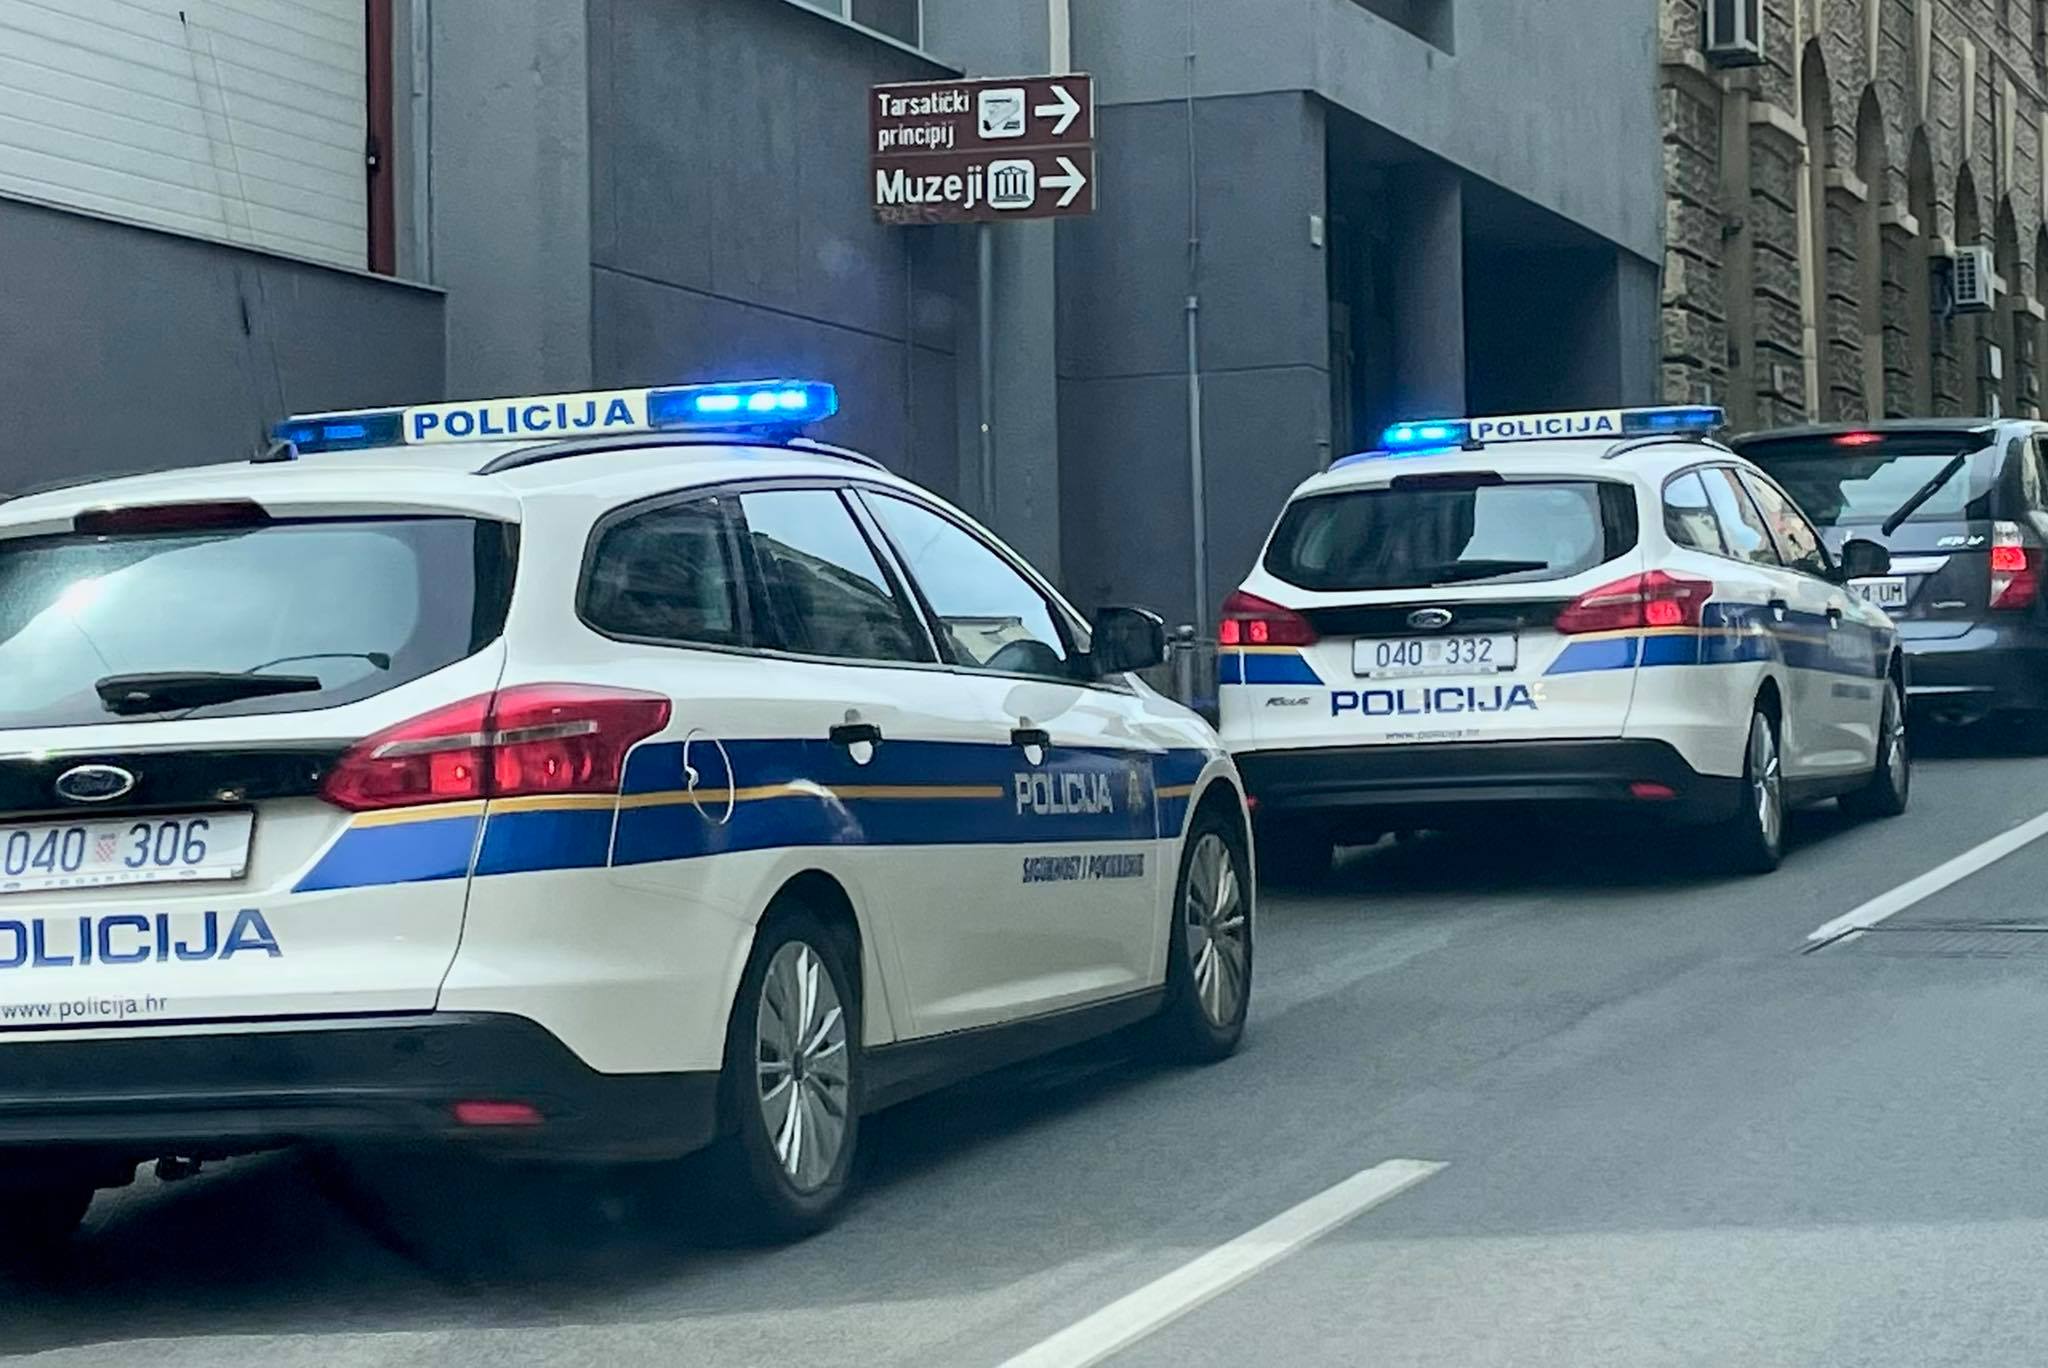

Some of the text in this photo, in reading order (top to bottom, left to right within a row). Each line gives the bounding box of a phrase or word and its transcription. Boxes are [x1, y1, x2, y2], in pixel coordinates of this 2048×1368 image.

[878, 90, 970, 117] Tarsatički
[878, 122, 954, 151] principij
[876, 165, 984, 209] Muzeji
[413, 399, 635, 439] POLICIJA
[1479, 416, 1613, 438] POLICIJA
[1376, 638, 1493, 667] 040 332
[1331, 684, 1538, 717] POLICIJA
[1014, 772, 1114, 815] POLICIJA
[5, 819, 209, 876] 040 306
[1, 994, 168, 1021] www.policija.hr
